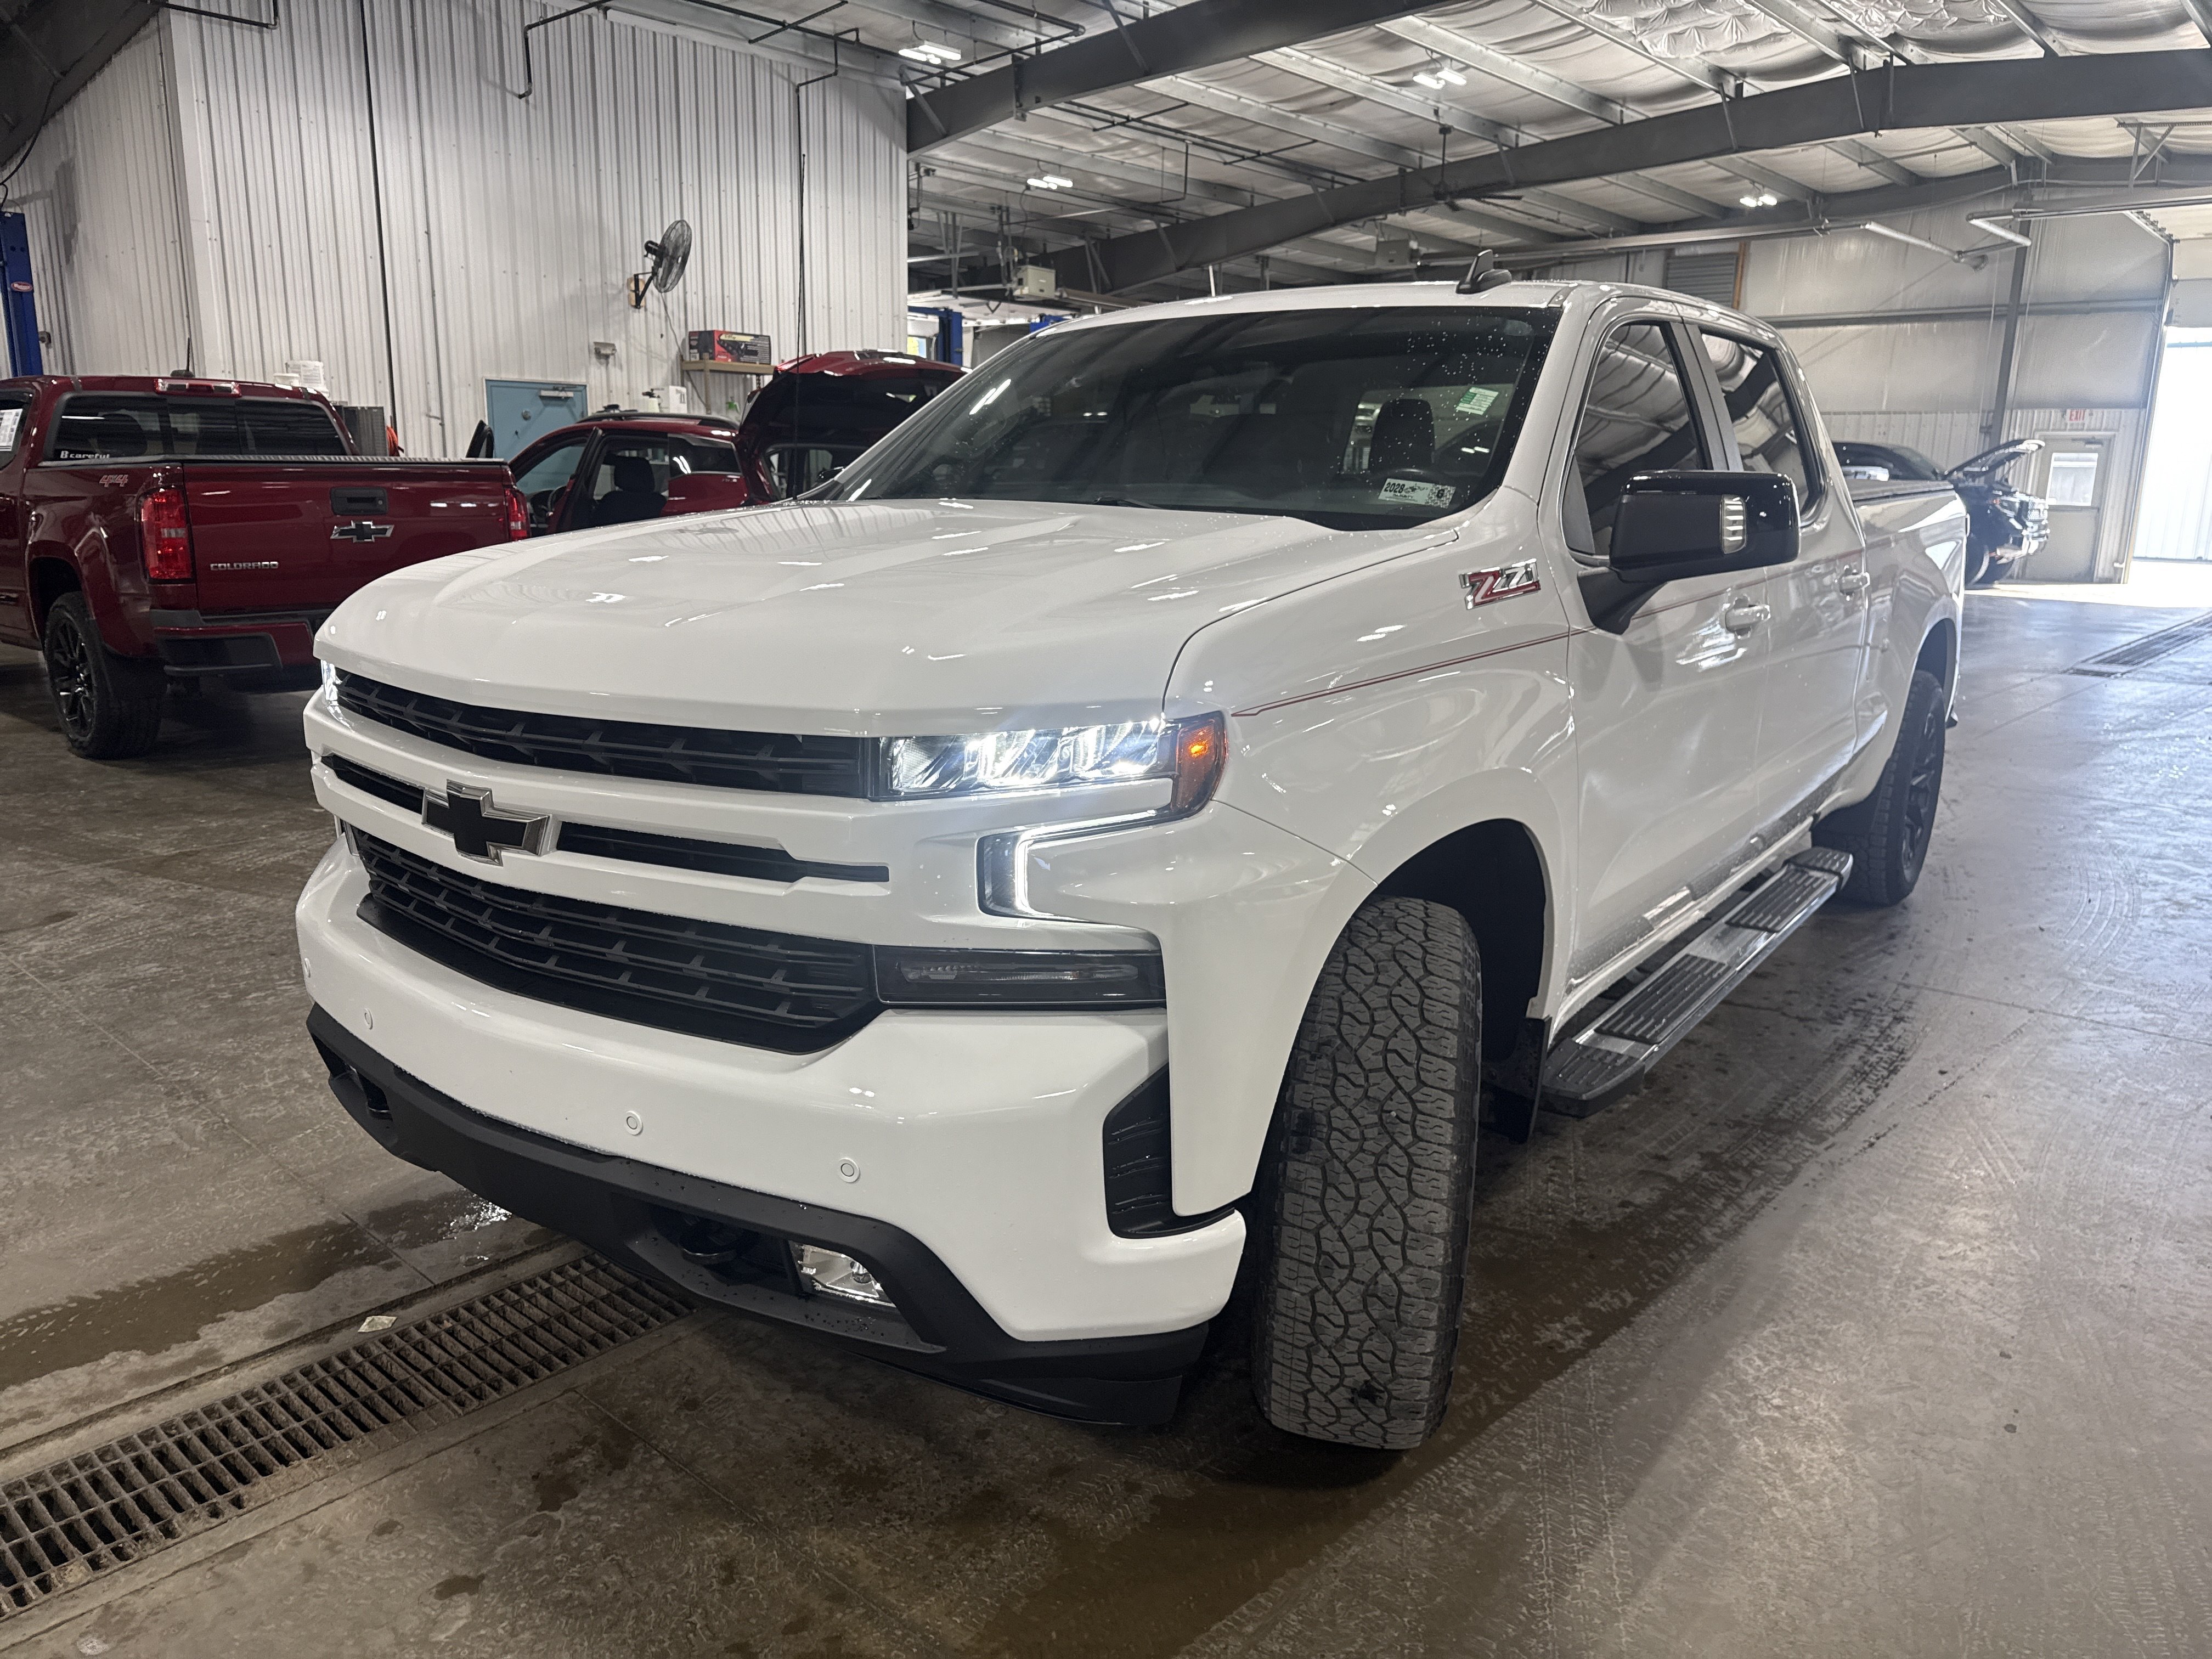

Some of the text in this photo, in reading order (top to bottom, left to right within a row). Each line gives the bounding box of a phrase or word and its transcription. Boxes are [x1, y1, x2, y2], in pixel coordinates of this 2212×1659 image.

[2069, 409, 2086, 422] EXIT
[1384, 482, 1406, 493] 2028
[210, 561, 279, 571] COLORADO
[1458, 558, 1542, 611] Z71
